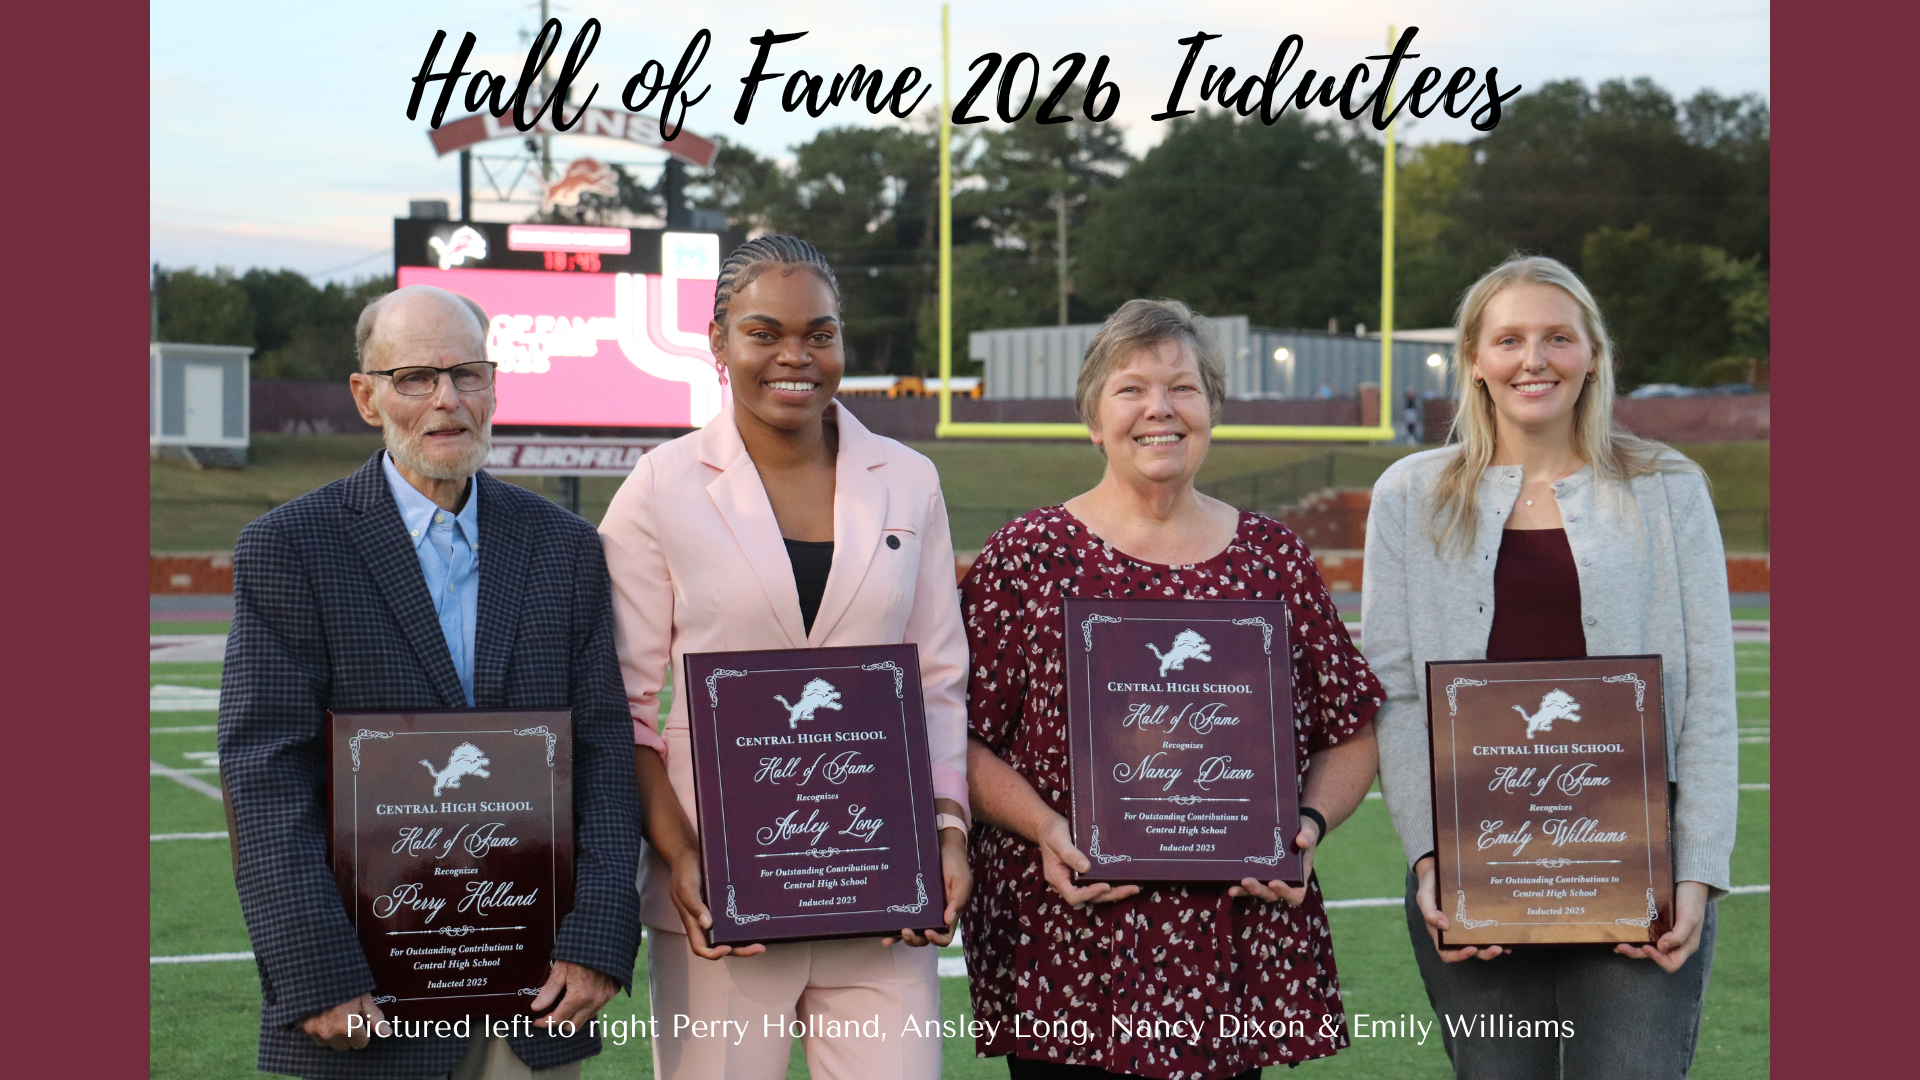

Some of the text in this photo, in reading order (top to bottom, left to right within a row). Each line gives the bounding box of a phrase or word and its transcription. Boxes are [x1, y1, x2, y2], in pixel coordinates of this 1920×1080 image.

[1108, 682, 1252, 693] CENTRAL HIGH SCHOOL
[1123, 703, 1240, 734] Hall of Fame
[736, 731, 886, 747] CENTRAL HIGH SCHOOL
[1162, 741, 1203, 750] Recognizes
[1473, 743, 1623, 755] CENTRAL HIGH SCHOOL
[754, 751, 875, 786] Hall of Fame
[1113, 752, 1254, 791] Nancy Dixon
[1489, 763, 1610, 796] Hall of Fame
[796, 793, 839, 802] Recognizes
[376, 801, 533, 814] CENTRAL HIGH SCHOOL
[1530, 804, 1572, 812] Recognizes
[1139, 812, 1185, 822] Outstanding
[1187, 812, 1239, 821] Contributions
[757, 804, 884, 845] Ansley Long
[1146, 826, 1227, 836] Central High School
[1478, 817, 1627, 856] Emily Williams
[392, 823, 519, 858] Hall of Fame
[434, 867, 479, 876] Recognizes
[760, 862, 888, 878] For Outstanding Contributions to
[784, 877, 867, 889] Central High School
[1490, 876, 1504, 884] For
[1505, 876, 1554, 885] Outstanding
[1556, 875, 1609, 884] Contributions
[1513, 889, 1596, 899] Central High School
[373, 881, 538, 923] Perry Holland
[799, 896, 857, 907] Inducted 2025
[1527, 907, 1563, 915] Inducted
[390, 948, 404, 956] For
[406, 946, 456, 957] Outstanding
[459, 944, 513, 954] Contributions
[413, 958, 500, 970] Central High School
[427, 978, 488, 988] Inducted 2025
